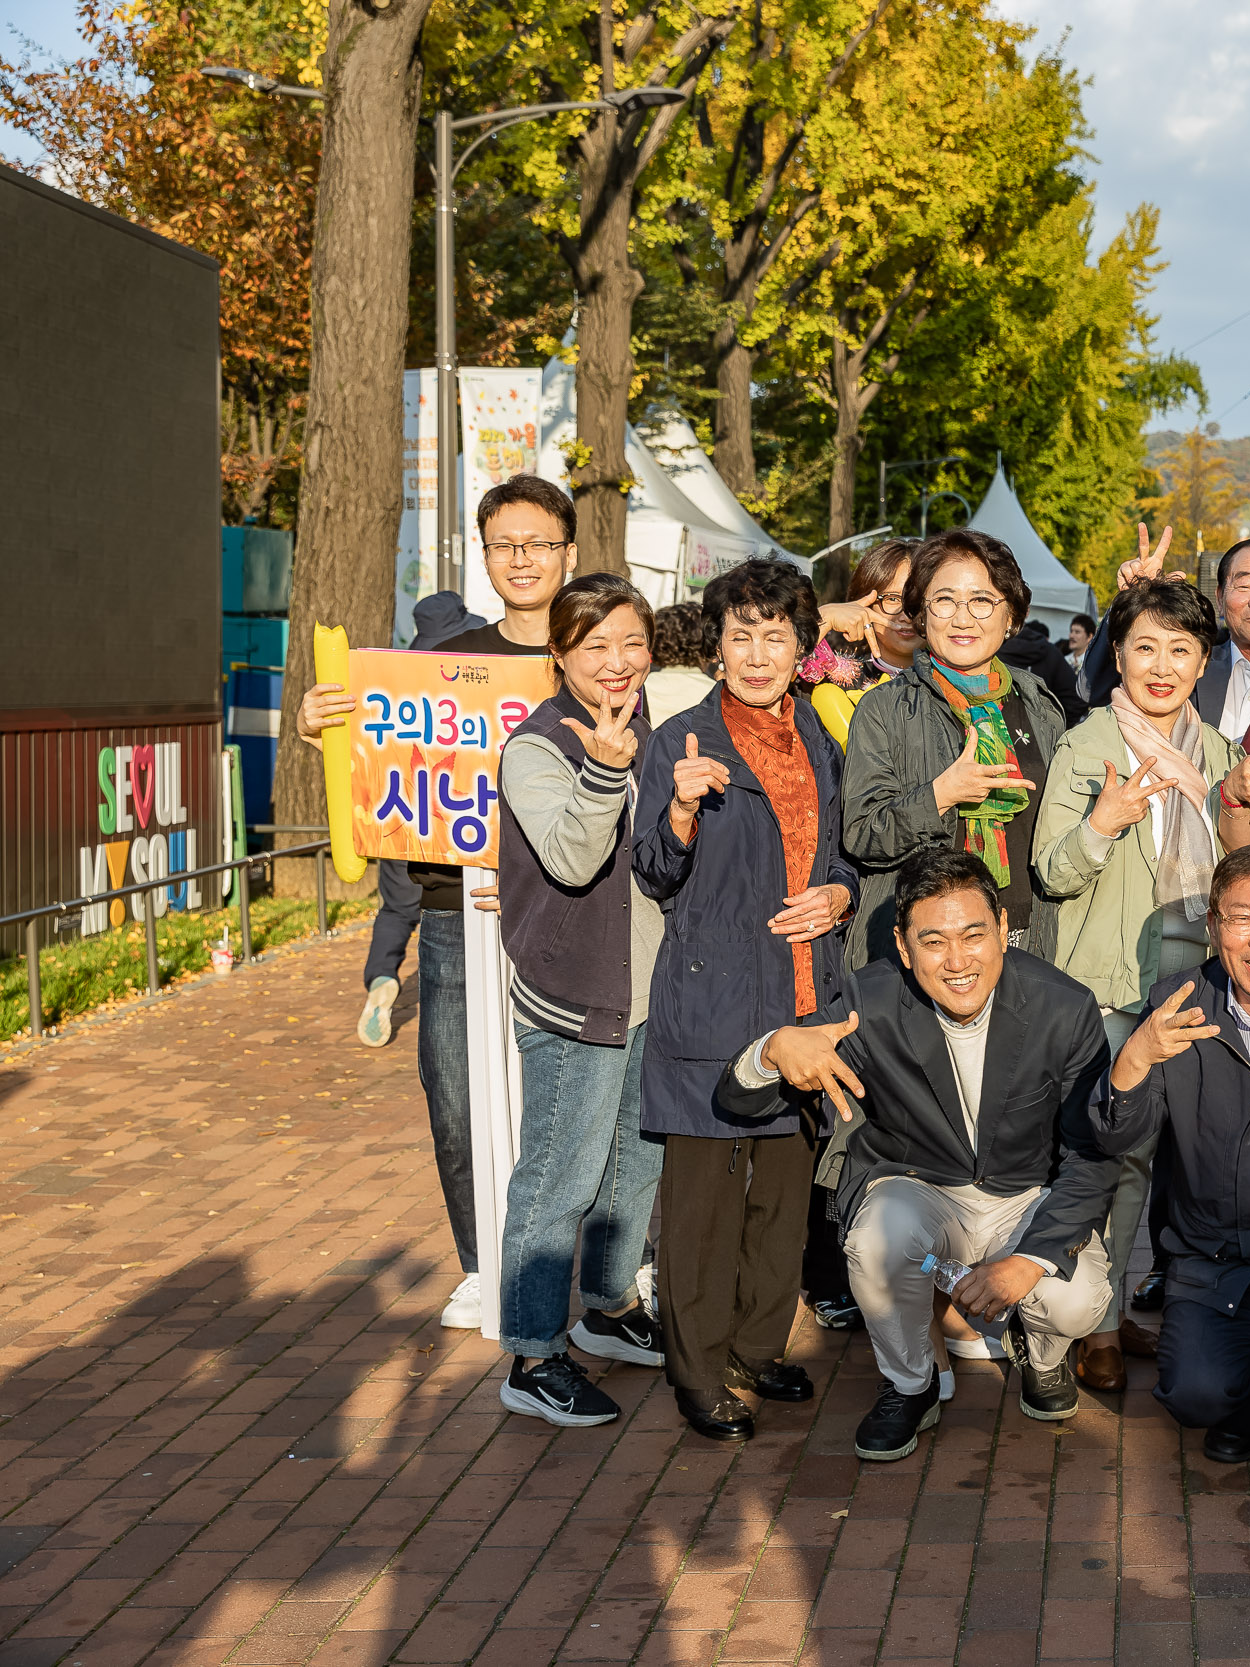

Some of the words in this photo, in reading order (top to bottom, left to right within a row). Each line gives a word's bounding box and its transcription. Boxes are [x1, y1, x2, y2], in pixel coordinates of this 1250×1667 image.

[508, 423, 535, 449] 가을
[364, 694, 487, 749] 구의3의
[131, 828, 202, 922] SOUL
